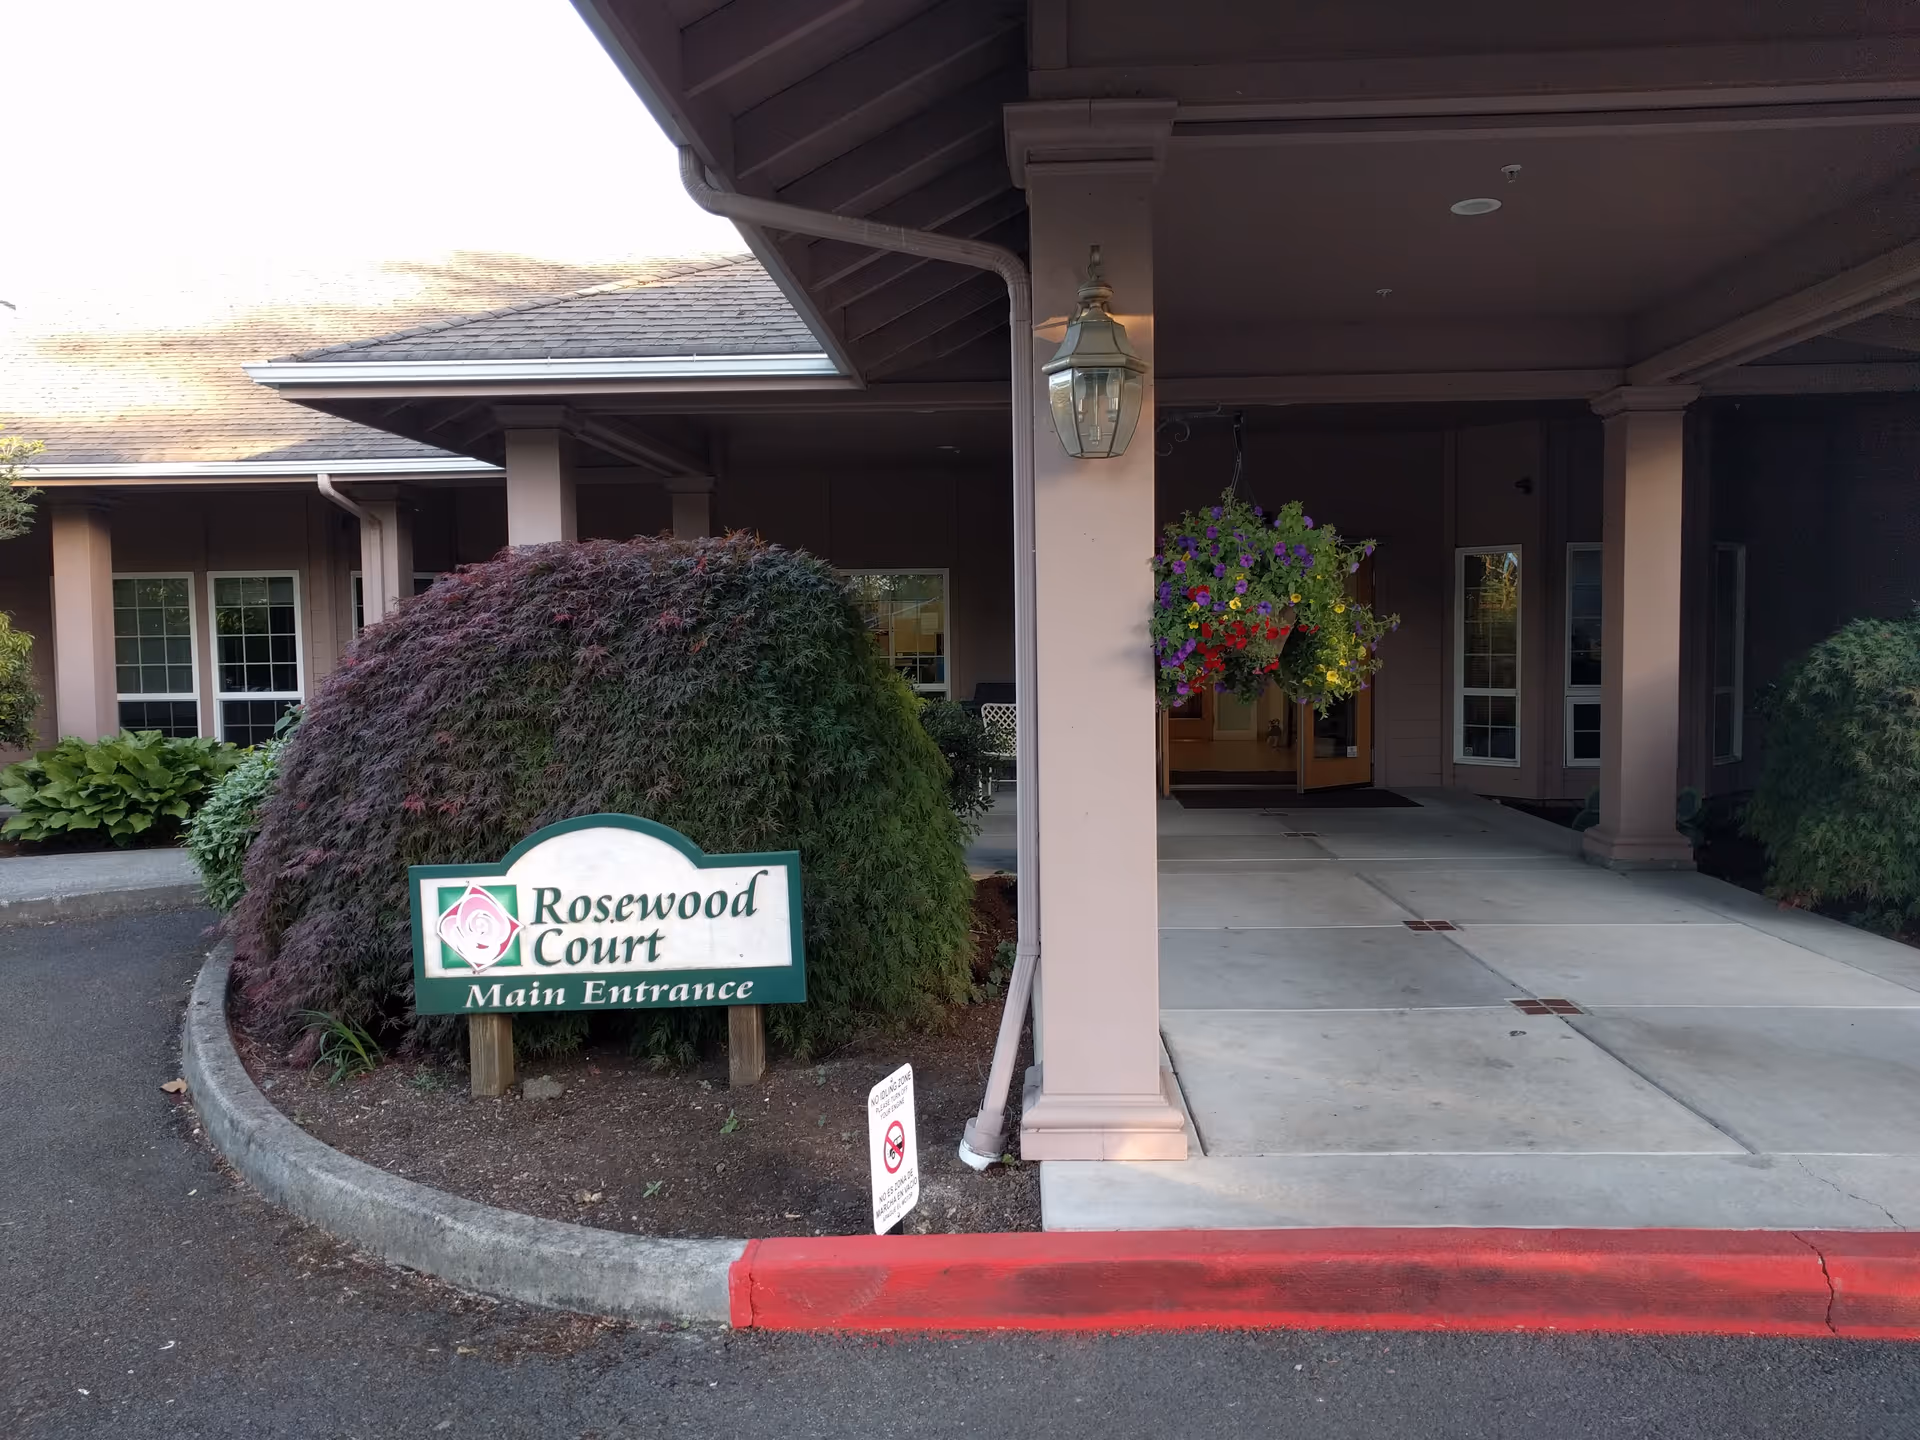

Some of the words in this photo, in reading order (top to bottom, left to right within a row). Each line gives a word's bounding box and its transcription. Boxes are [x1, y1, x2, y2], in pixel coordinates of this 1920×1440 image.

[531, 869, 768, 925] Rosewood
[534, 927, 666, 967] Court
[464, 981, 566, 1009] Main
[580, 979, 754, 1006] Entrance
[871, 1095, 879, 1107] NO
[880, 1081, 897, 1100] IDLING
[898, 1070, 911, 1088] ZONE
[876, 1196, 897, 1219] MARCHA
[897, 1188, 904, 1201] EN
[879, 1192, 886, 1203] NO
[887, 1186, 894, 1197] ES
[894, 1175, 907, 1191] ZONA
[908, 1168, 913, 1180] DE
